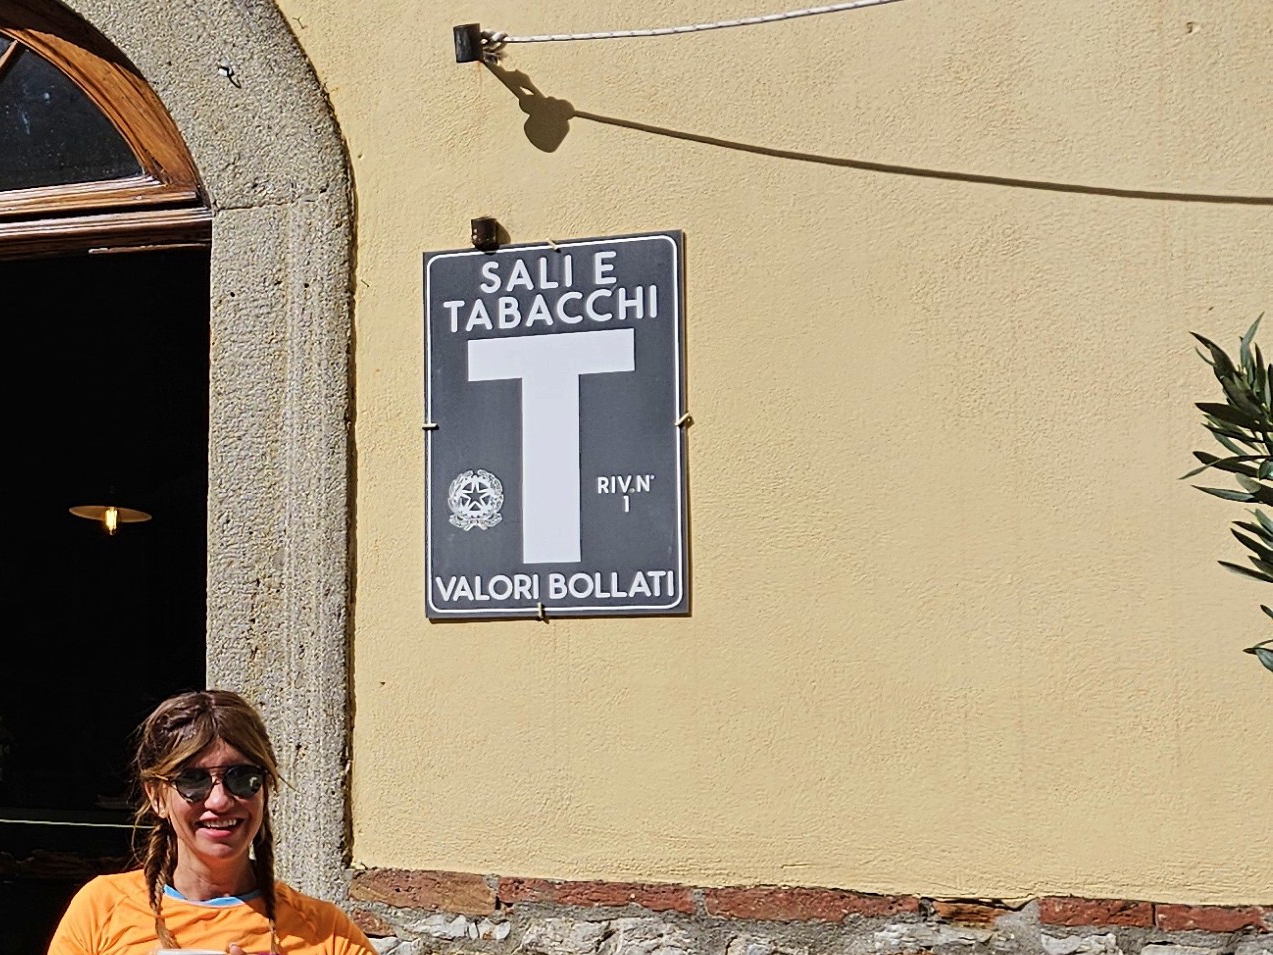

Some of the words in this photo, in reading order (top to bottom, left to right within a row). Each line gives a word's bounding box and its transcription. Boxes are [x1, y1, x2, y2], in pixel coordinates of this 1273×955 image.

[480, 254, 573, 294] SALI
[595, 250, 618, 285] E
[443, 285, 658, 333] TABACCHI
[468, 328, 635, 564] T
[622, 495, 631, 514] 1
[435, 573, 540, 602] VALORI
[547, 569, 676, 600] BOLLATI
